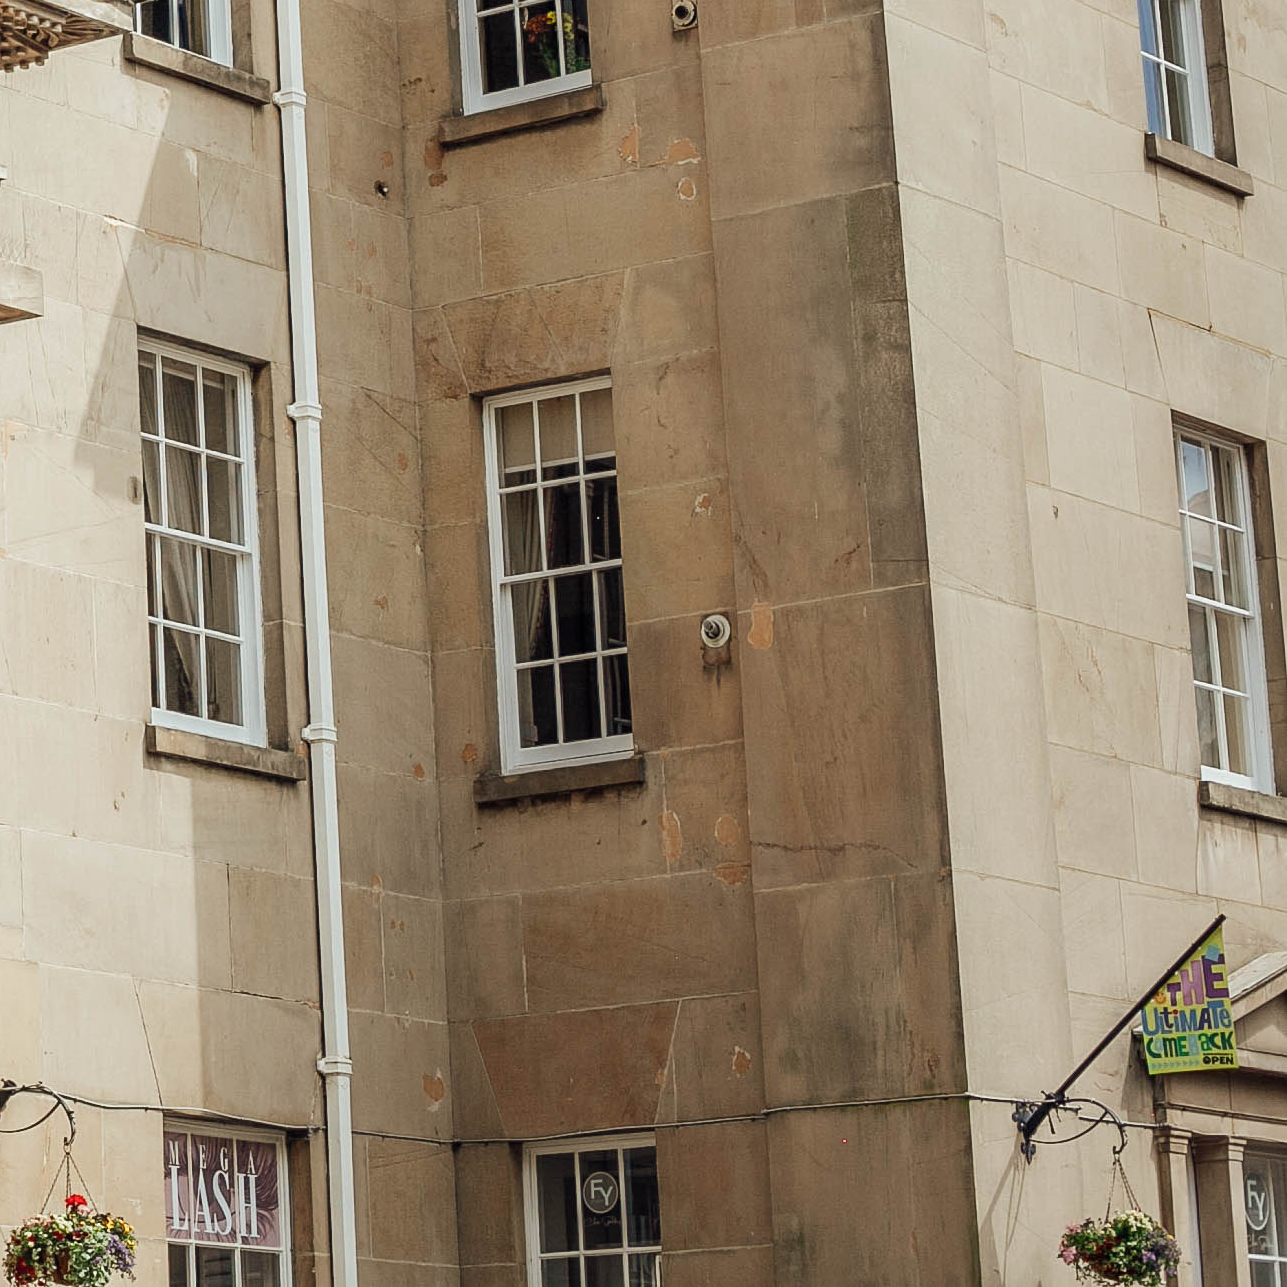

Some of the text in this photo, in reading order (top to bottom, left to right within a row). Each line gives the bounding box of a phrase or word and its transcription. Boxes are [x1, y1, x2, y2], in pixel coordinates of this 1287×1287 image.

[1167, 953, 1230, 1006] THE
[1202, 1055, 1234, 1065] OPEN
[168, 1139, 258, 1176] MEGA
[169, 1165, 261, 1239] LASH
